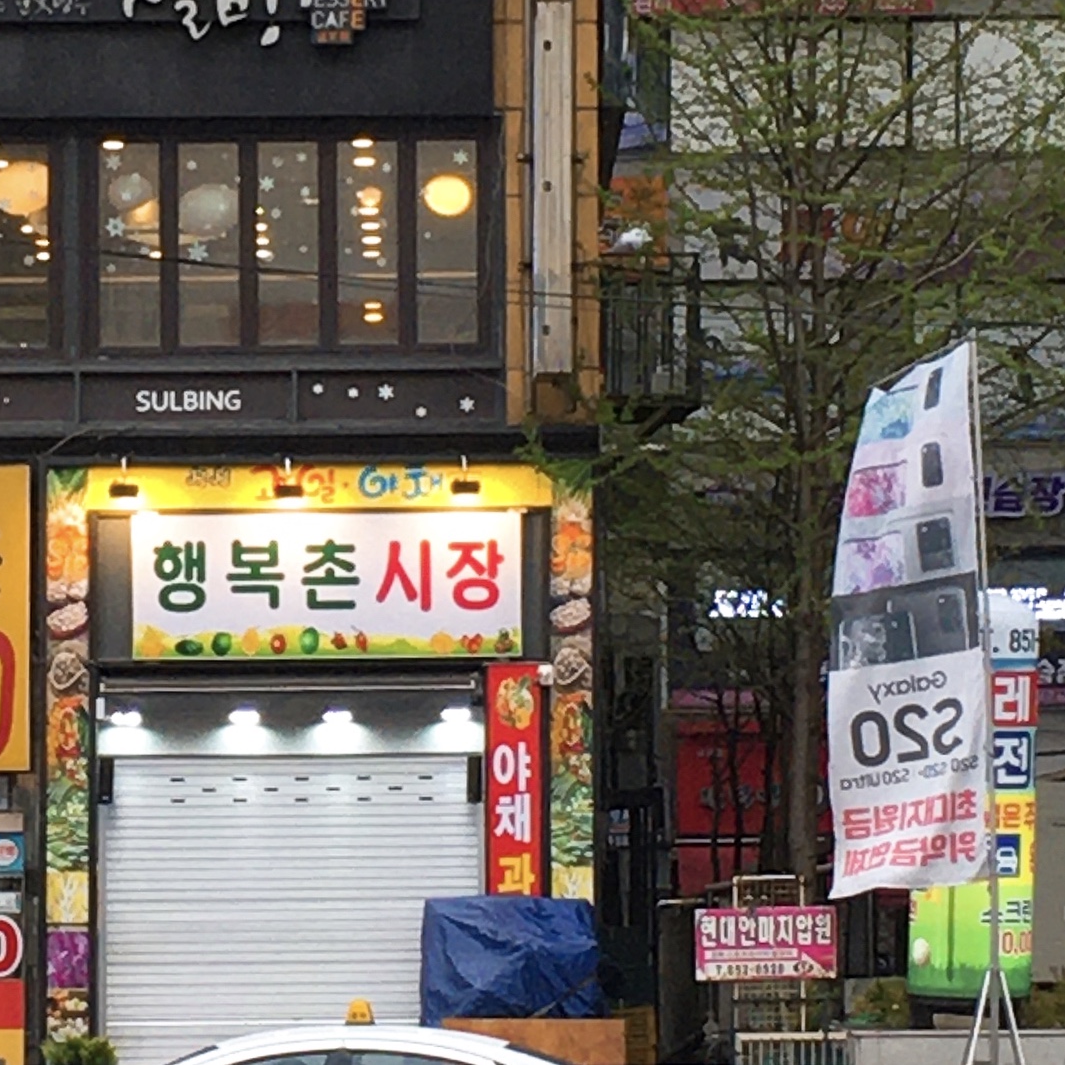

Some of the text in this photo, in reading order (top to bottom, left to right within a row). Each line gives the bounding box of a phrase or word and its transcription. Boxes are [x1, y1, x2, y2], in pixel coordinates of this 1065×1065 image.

[310, 8, 366, 31] CAFE
[135, 389, 242, 413] SULBING
[153, 538, 505, 613] 행복촌시장
[492, 742, 532, 845] 야채
